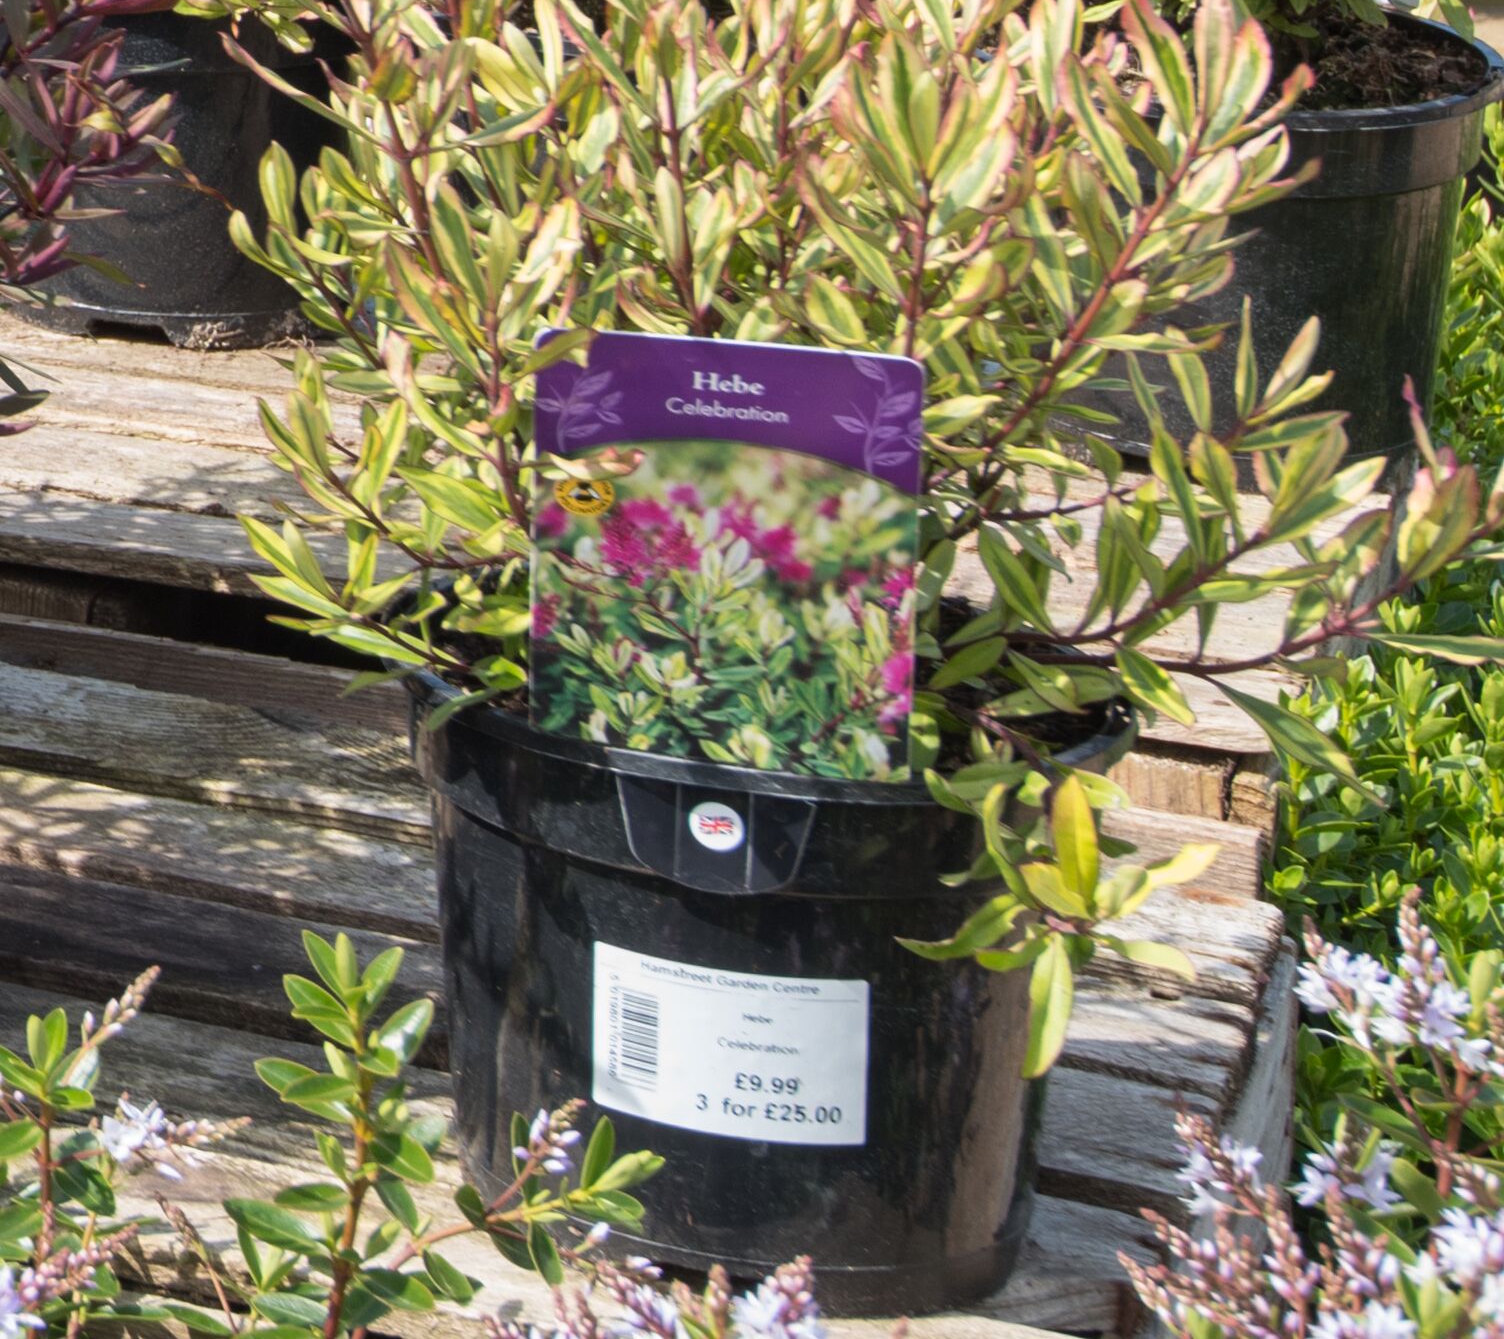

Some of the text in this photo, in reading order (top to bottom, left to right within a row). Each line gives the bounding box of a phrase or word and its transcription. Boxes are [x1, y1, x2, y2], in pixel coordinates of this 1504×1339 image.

[692, 370, 767, 396] Hebe
[665, 397, 790, 424] Celebration
[640, 960, 820, 995] Hamstreet Garden Centre
[742, 1012, 773, 1025] Hebe
[717, 1036, 800, 1055] Celebration
[734, 1072, 800, 1096] £9.99
[695, 1093, 843, 1124] 3 for £25.00
